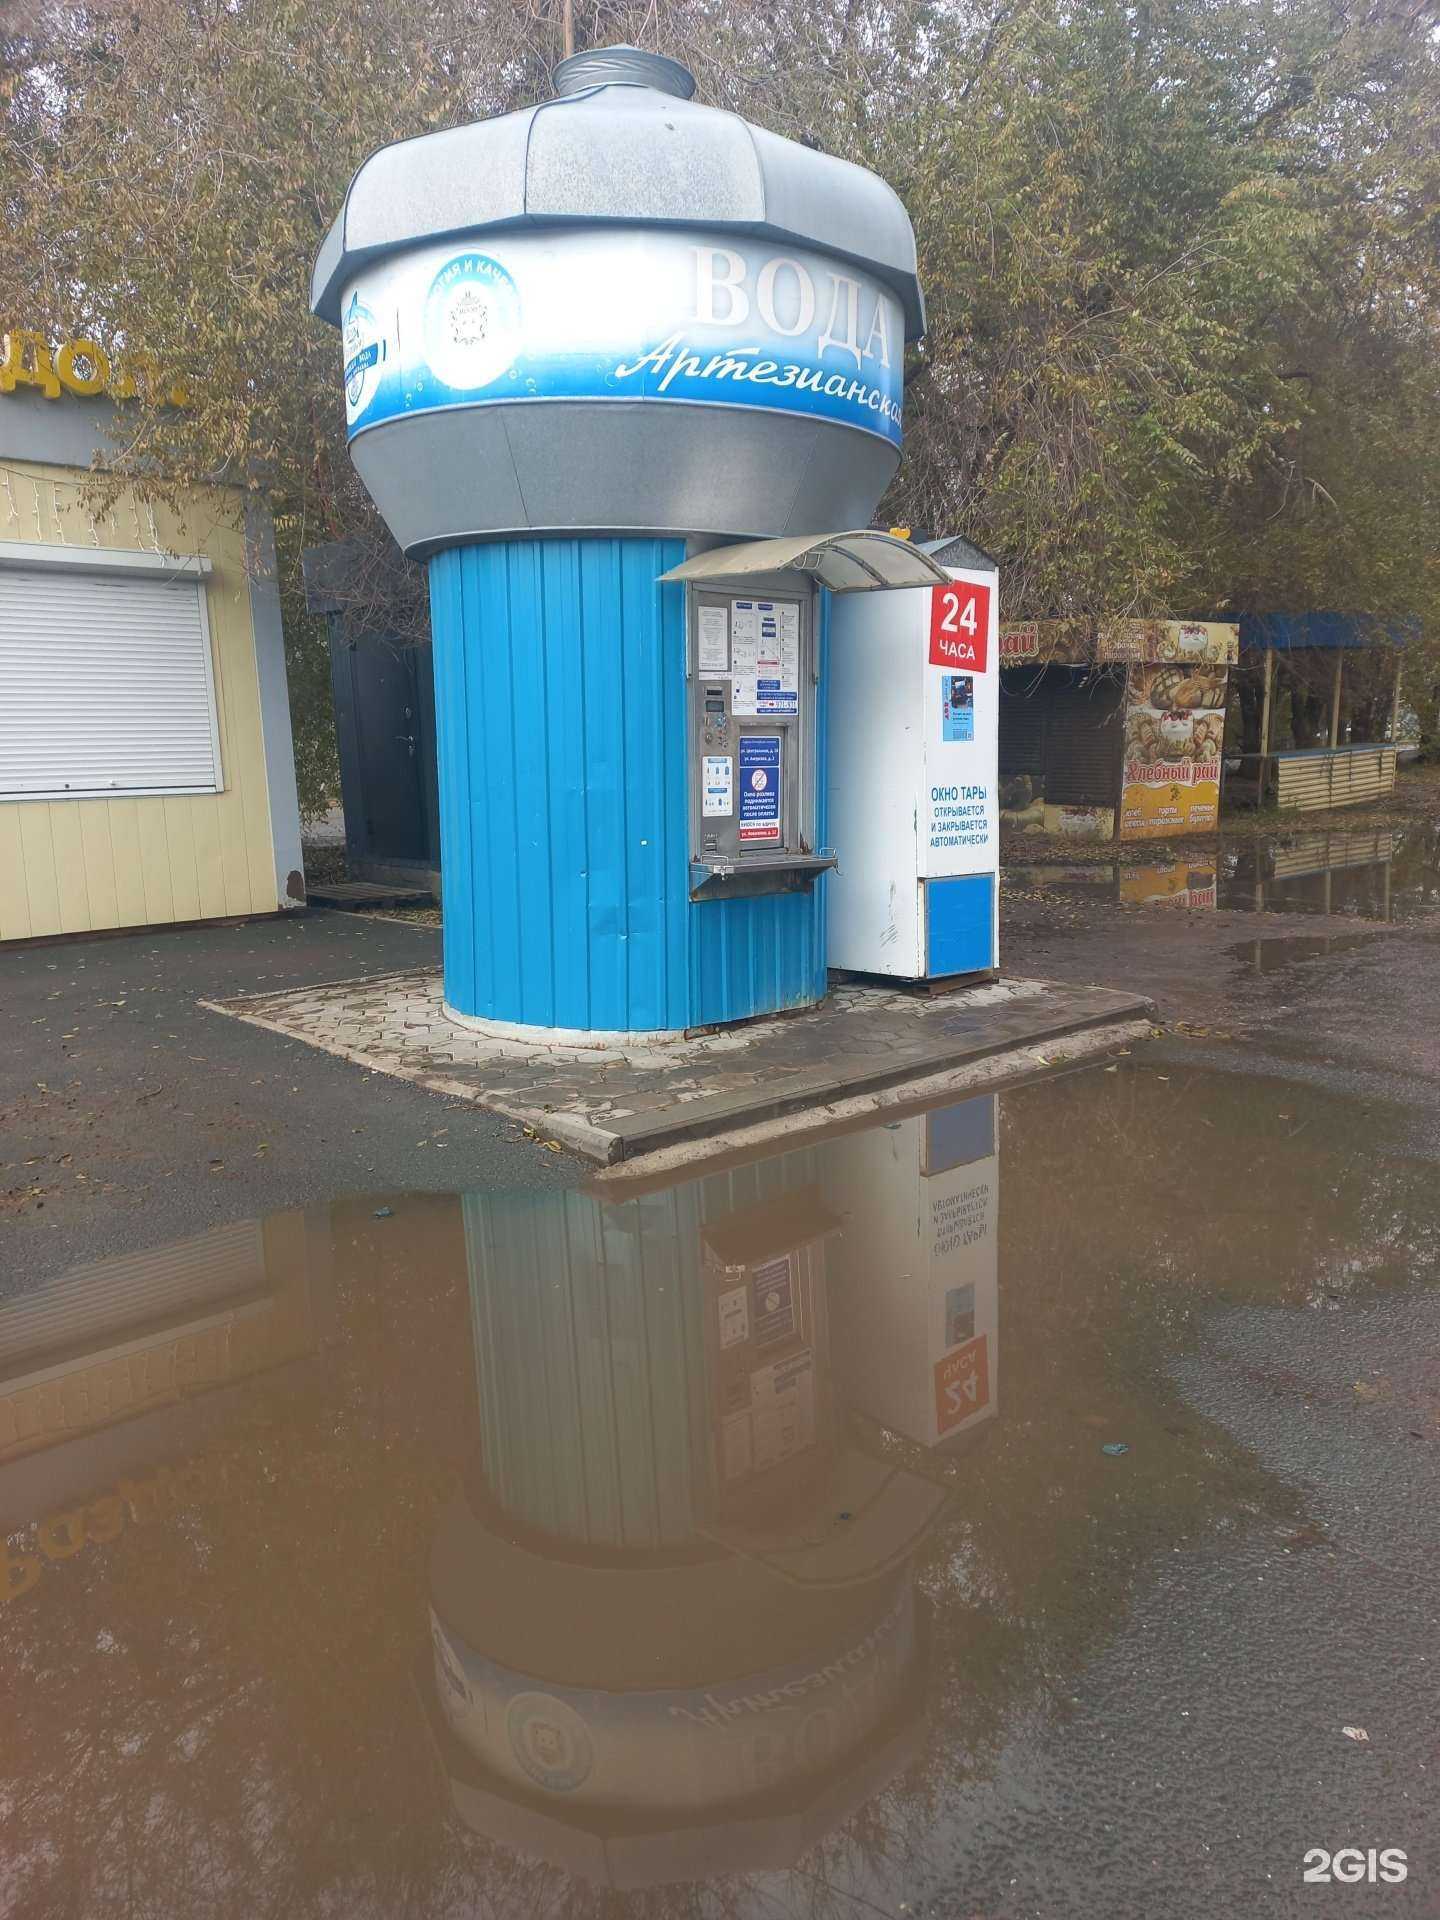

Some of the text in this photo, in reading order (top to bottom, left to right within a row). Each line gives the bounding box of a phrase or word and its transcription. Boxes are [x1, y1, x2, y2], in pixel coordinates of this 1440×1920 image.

[690, 246, 890, 371] ВОДА
[941, 592, 977, 636] 24
[999, 621, 1040, 657] ай
[939, 639, 976, 661] ЧАСА
[931, 786, 987, 801] ОКНО ТАРЫ
[934, 805, 984, 818] ОТКРЫВАЕТСЯ
[931, 820, 988, 832] И ЗАКРЫВАЕТСЯ
[930, 834, 989, 847] АВТОМАТИЧЕСКИ
